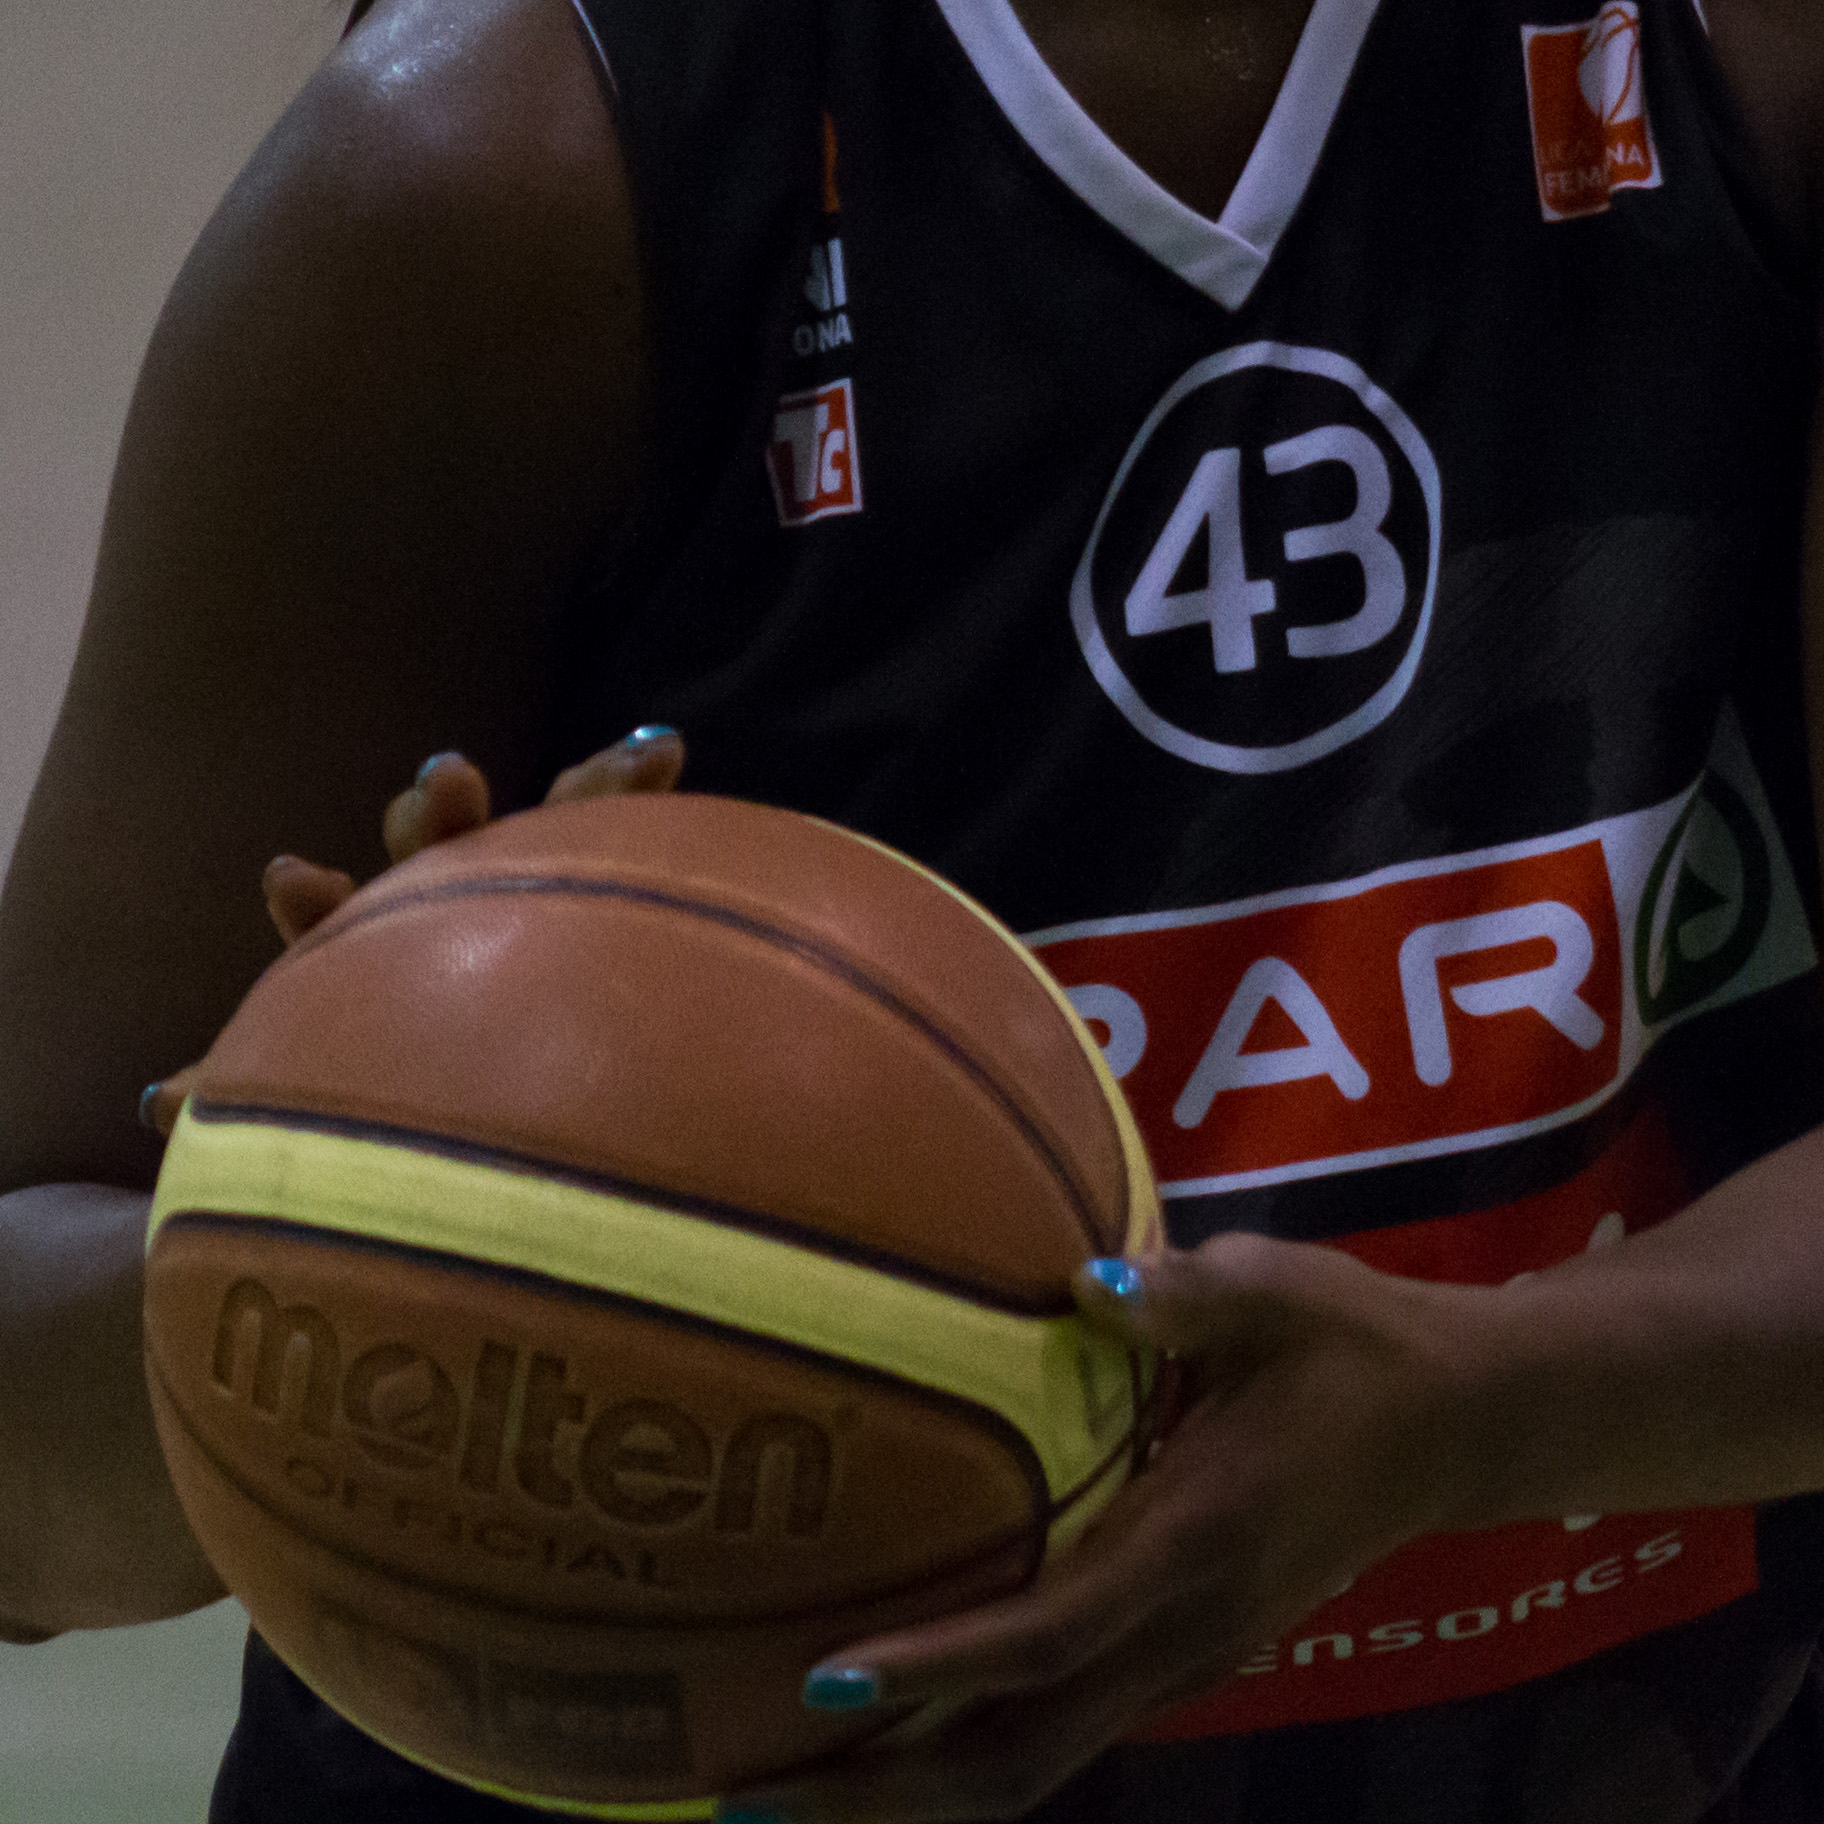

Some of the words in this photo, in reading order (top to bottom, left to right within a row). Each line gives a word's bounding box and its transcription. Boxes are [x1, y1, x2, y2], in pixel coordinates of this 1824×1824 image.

[1124, 423, 1407, 674] 43
[210, 1276, 836, 1542] molten
[285, 1456, 674, 1587] OFFICIAL
